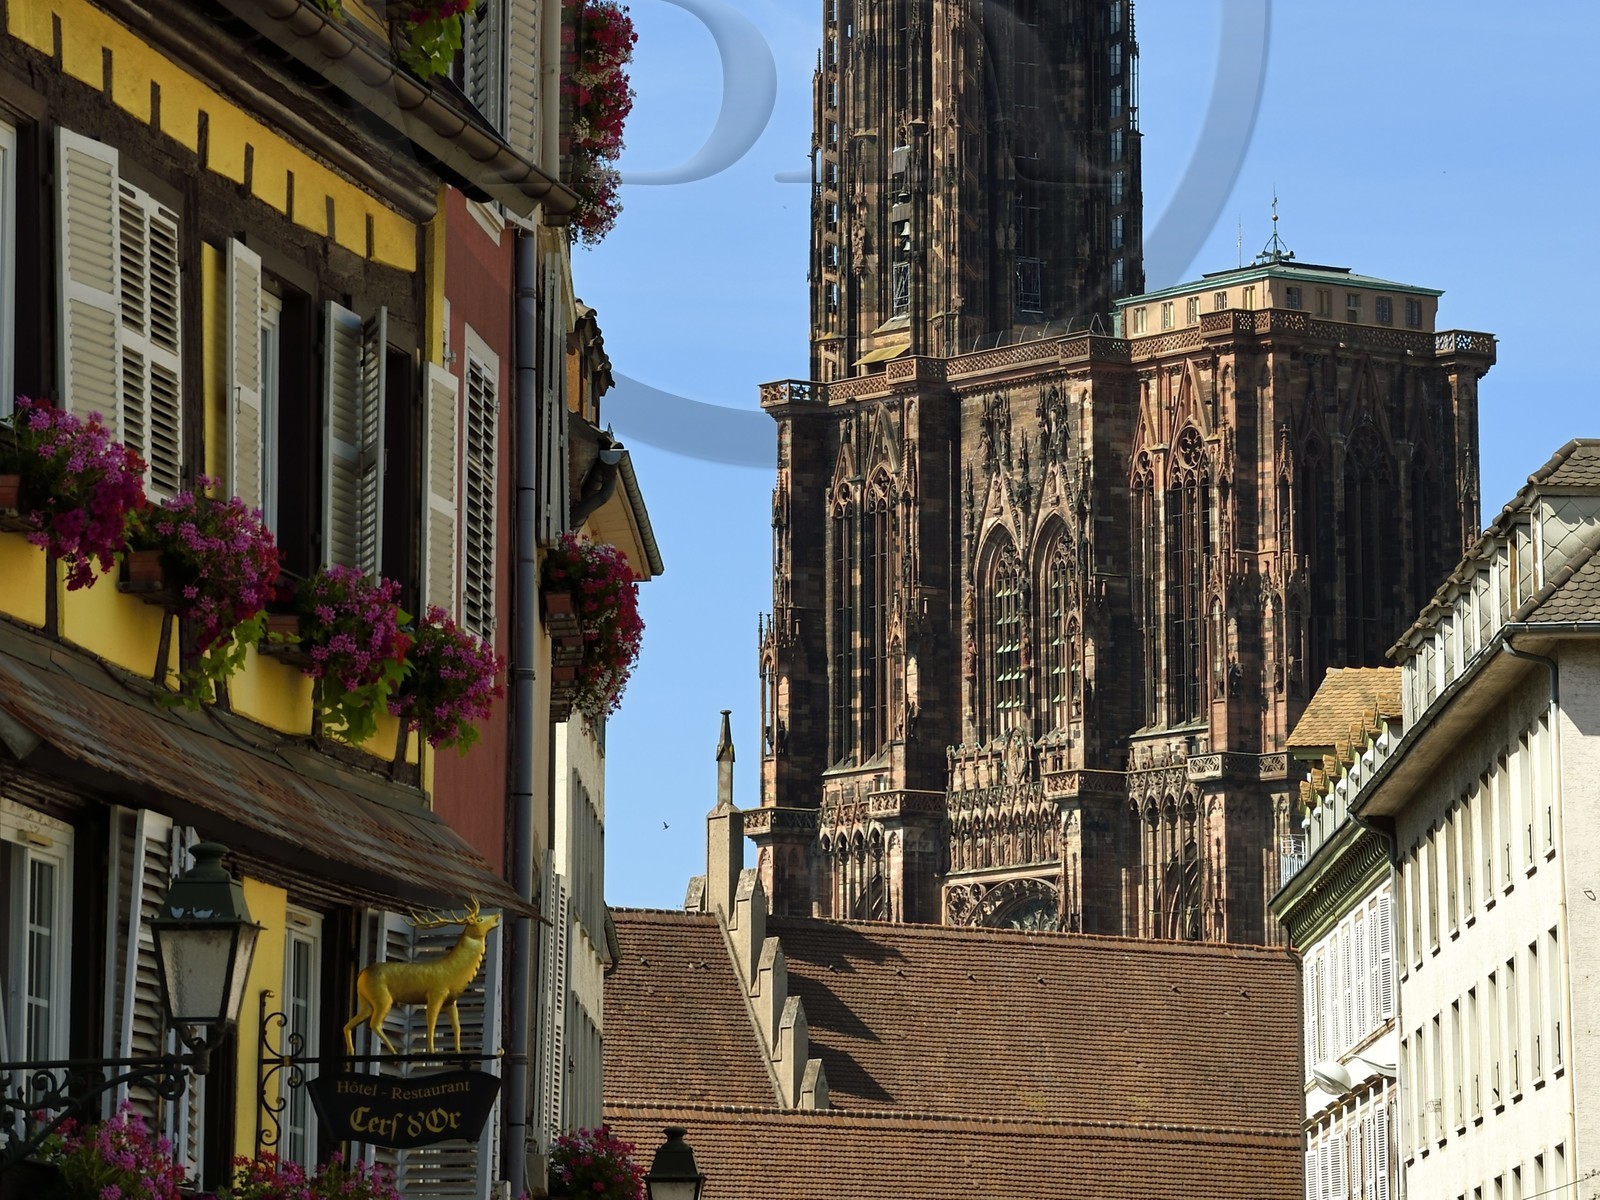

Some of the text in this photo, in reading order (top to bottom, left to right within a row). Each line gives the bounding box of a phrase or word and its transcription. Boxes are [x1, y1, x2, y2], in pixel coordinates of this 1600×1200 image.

[337, 1081, 377, 1097] Hôtel
[391, 1081, 470, 1100] Restaurant
[350, 1106, 404, 1141] Cerf
